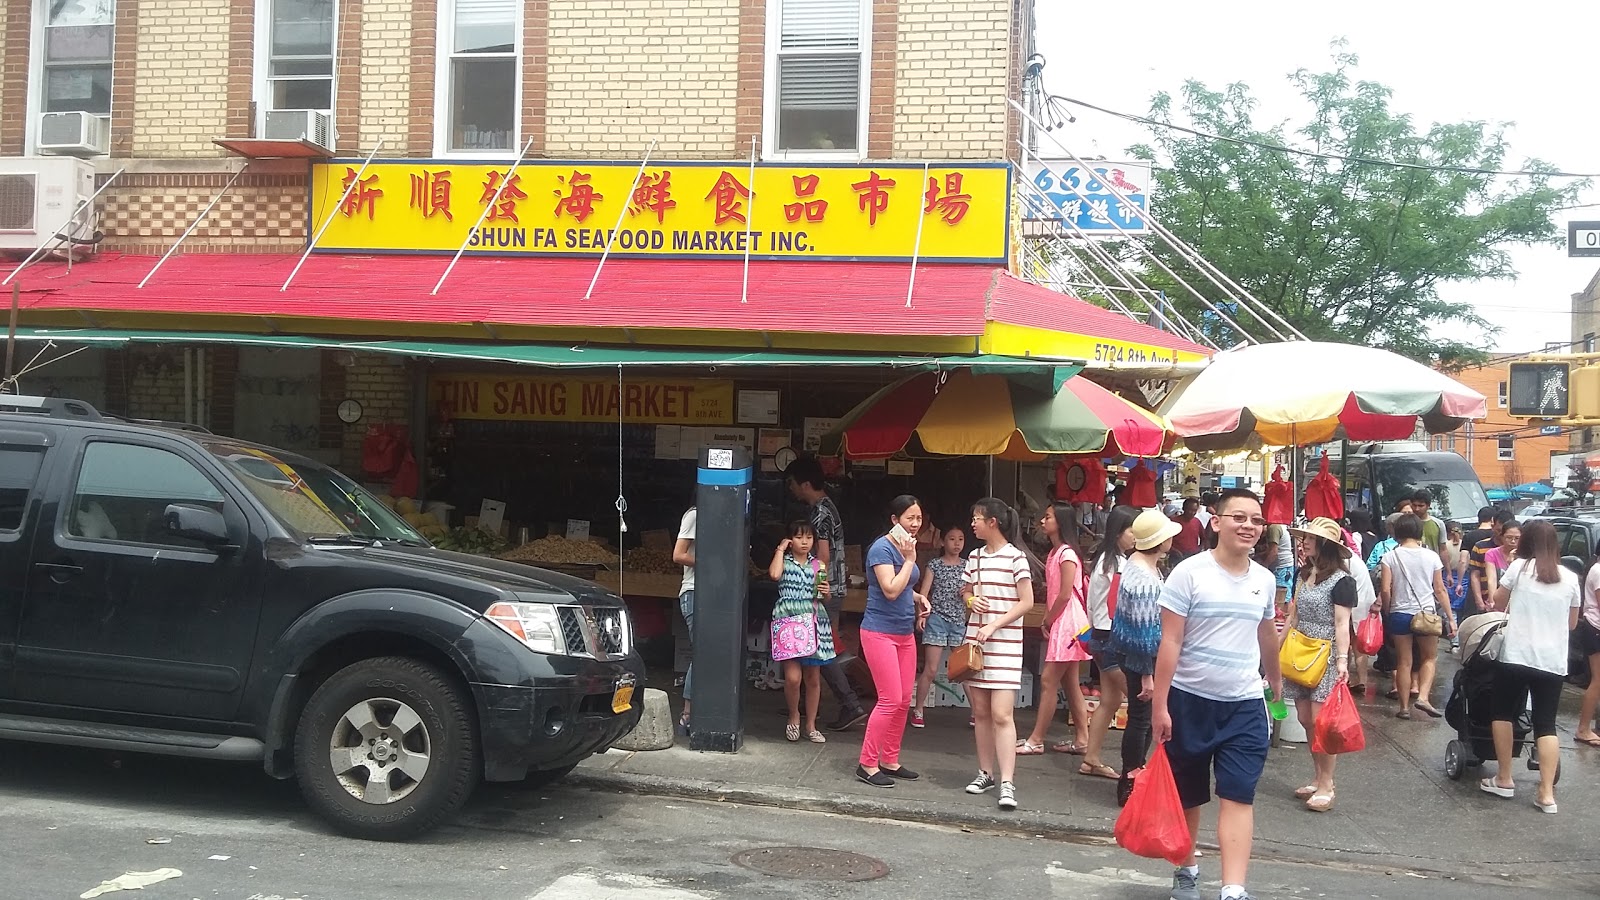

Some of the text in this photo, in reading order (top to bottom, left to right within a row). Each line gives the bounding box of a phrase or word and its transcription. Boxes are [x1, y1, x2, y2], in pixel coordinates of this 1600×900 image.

[1034, 167, 1108, 192] 668
[337, 166, 972, 227] 新順發海鮮食品市場
[468, 227, 815, 252] SHUN FA SEAFOOD MARKET INC.
[1586, 231, 1600, 247] O
[1094, 343, 1124, 362] 5724
[1127, 347, 1146, 362] 8th
[493, 381, 567, 416] SANG
[581, 384, 695, 418] MARKET
[701, 399, 718, 407] 5724
